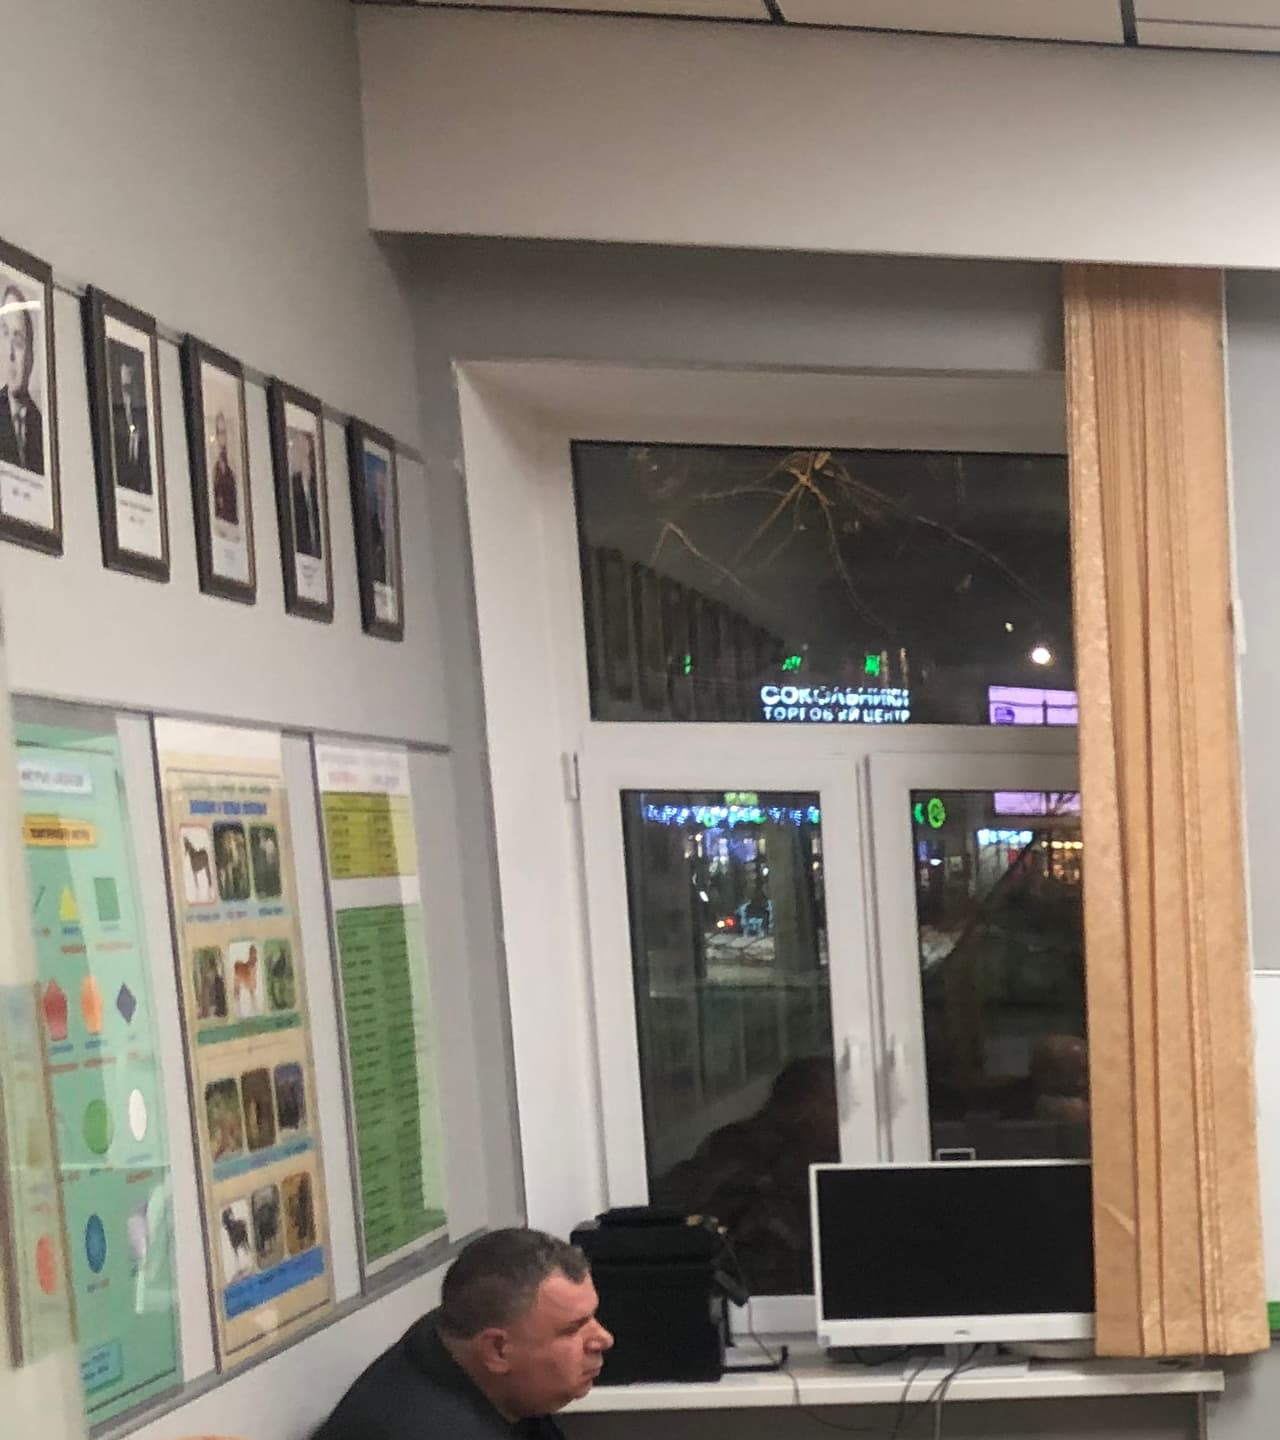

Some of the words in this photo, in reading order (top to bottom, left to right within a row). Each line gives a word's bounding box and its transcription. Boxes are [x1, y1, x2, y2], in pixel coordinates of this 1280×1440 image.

[760, 685, 909, 706] СОКОЛЬНИКИ
[763, 706, 860, 721] ТОРГОВЫЙ
[863, 708, 910, 723] ЦЕНТР
